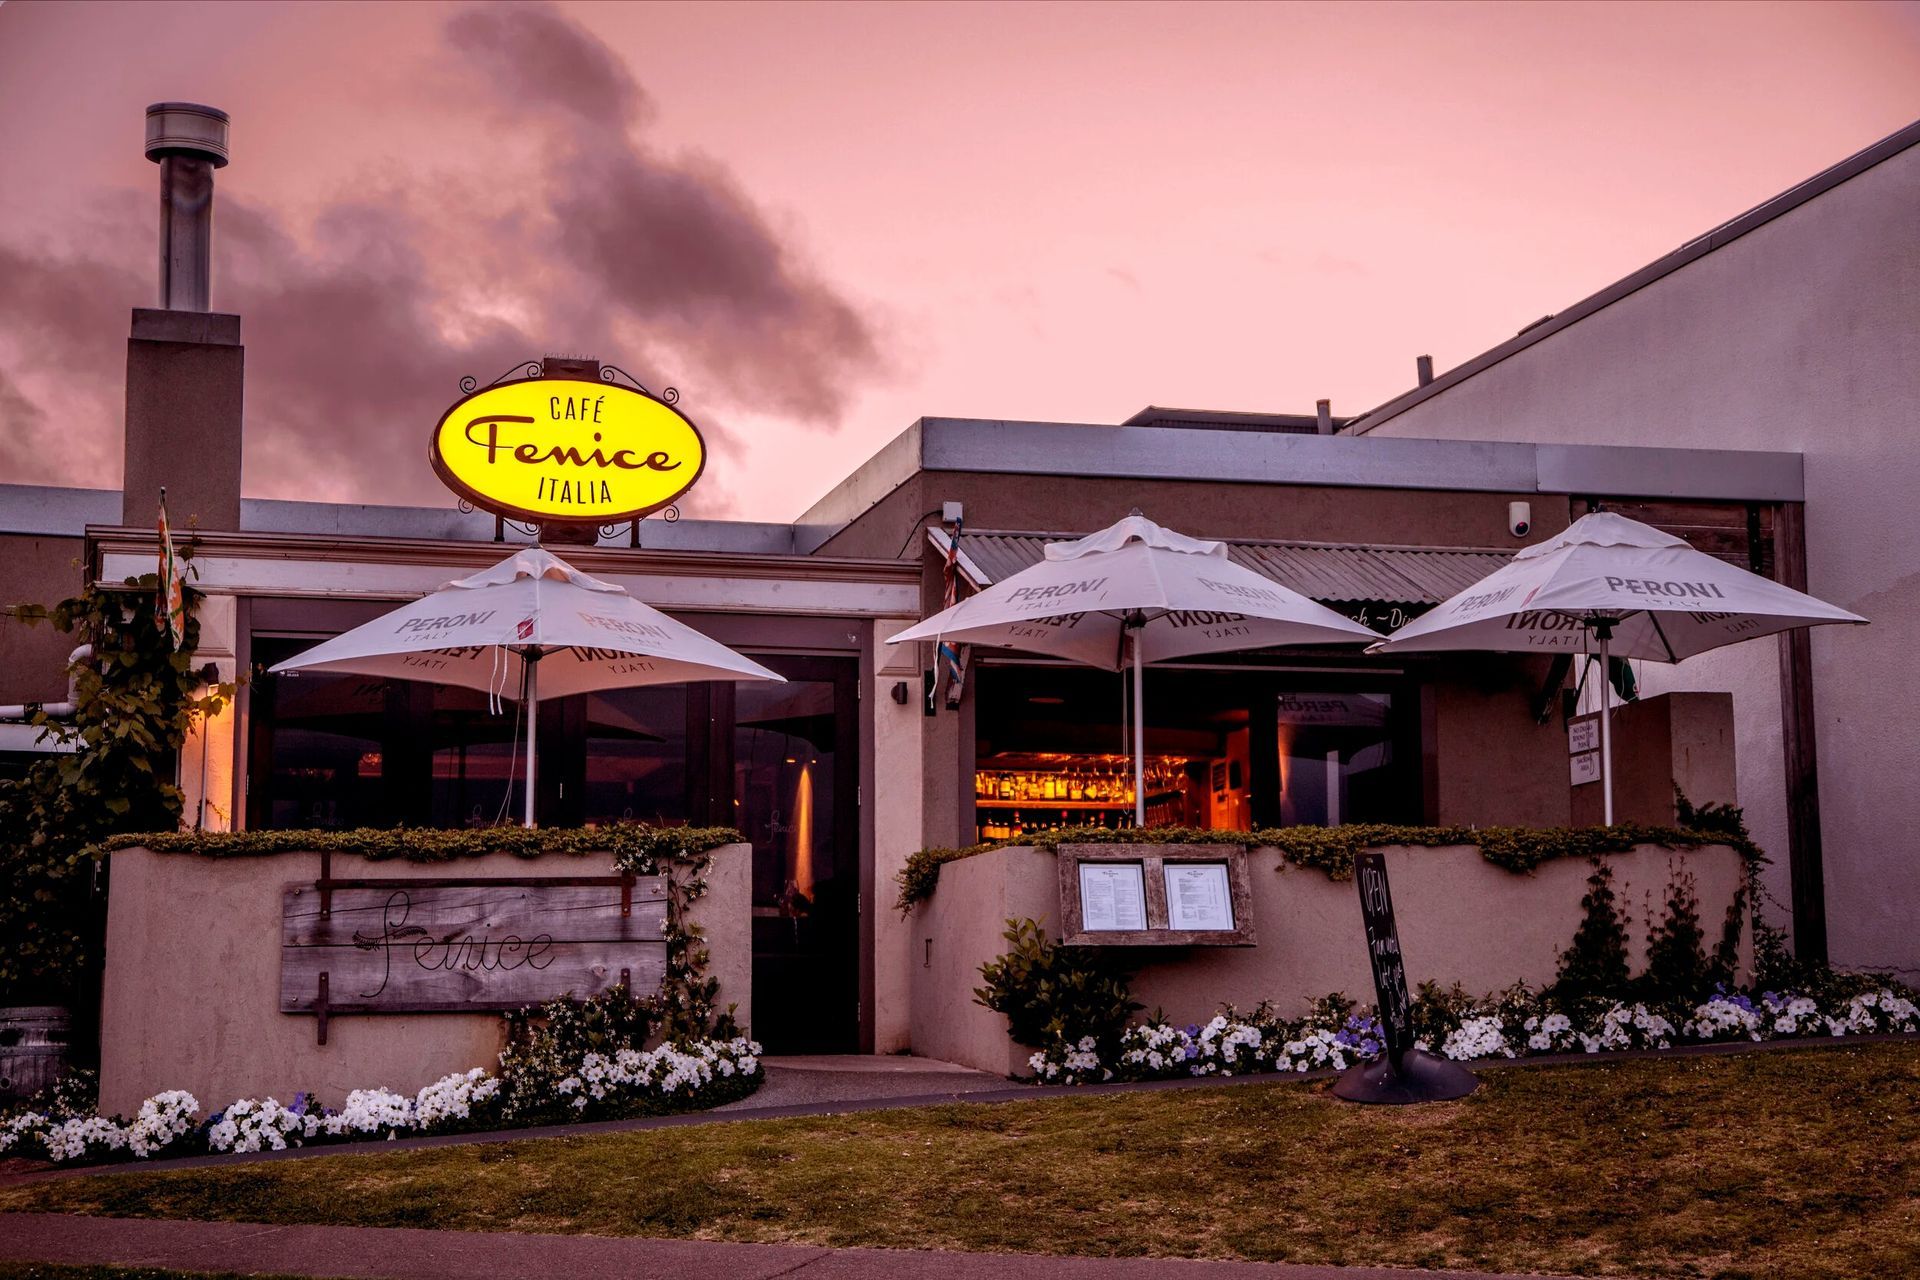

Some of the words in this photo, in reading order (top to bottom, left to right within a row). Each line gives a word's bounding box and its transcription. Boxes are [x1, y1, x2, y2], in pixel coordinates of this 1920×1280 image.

[550, 395, 605, 423] CAFÉ
[465, 414, 682, 472] Fenice
[537, 476, 613, 504] ITALIA
[1005, 577, 1109, 604] PERONI
[1449, 584, 1520, 615] PERONI
[1605, 575, 1726, 599] PERONI
[1016, 600, 1066, 612] ITALY
[394, 610, 497, 634] PERONI
[404, 631, 454, 642] ITALY
